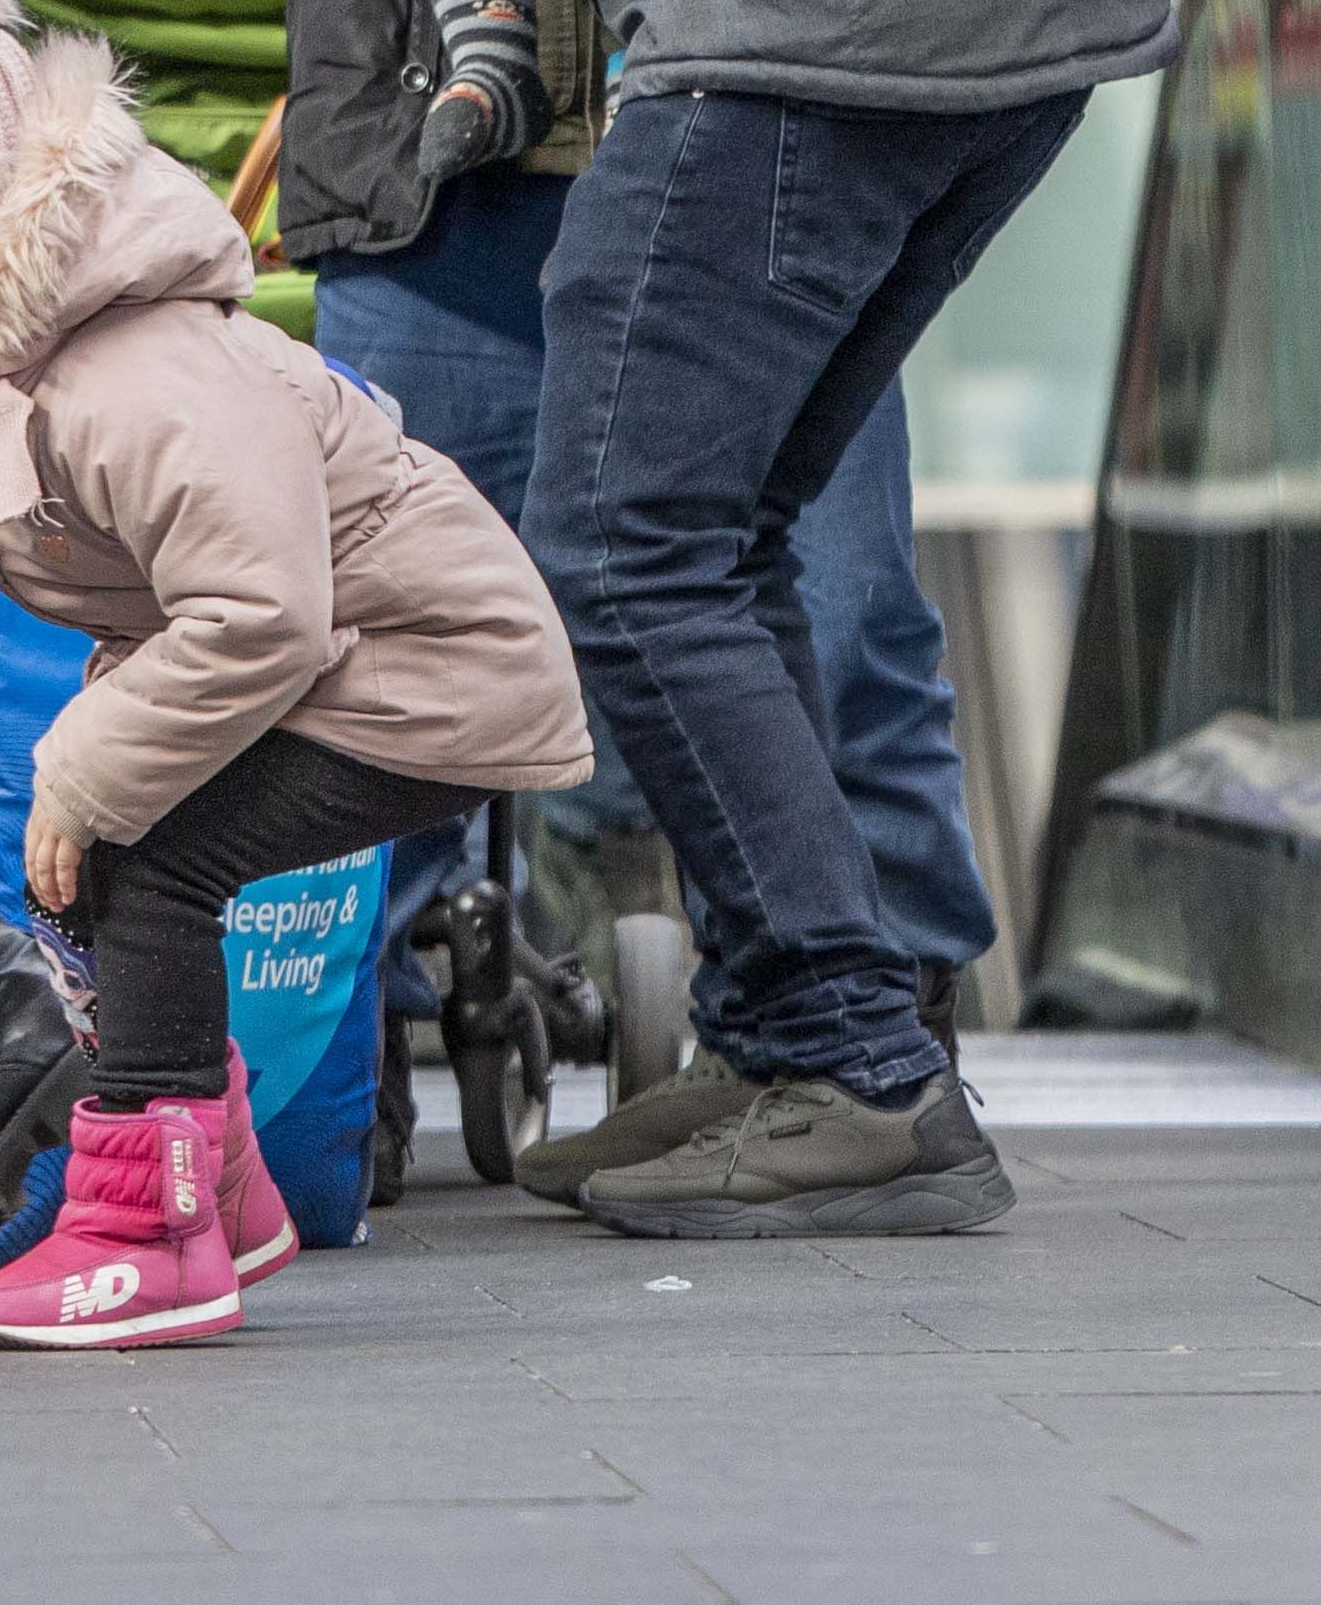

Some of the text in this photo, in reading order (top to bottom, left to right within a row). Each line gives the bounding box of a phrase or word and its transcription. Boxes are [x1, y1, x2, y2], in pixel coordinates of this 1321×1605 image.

[221, 883, 359, 944] leeping &
[240, 948, 326, 996] Living
